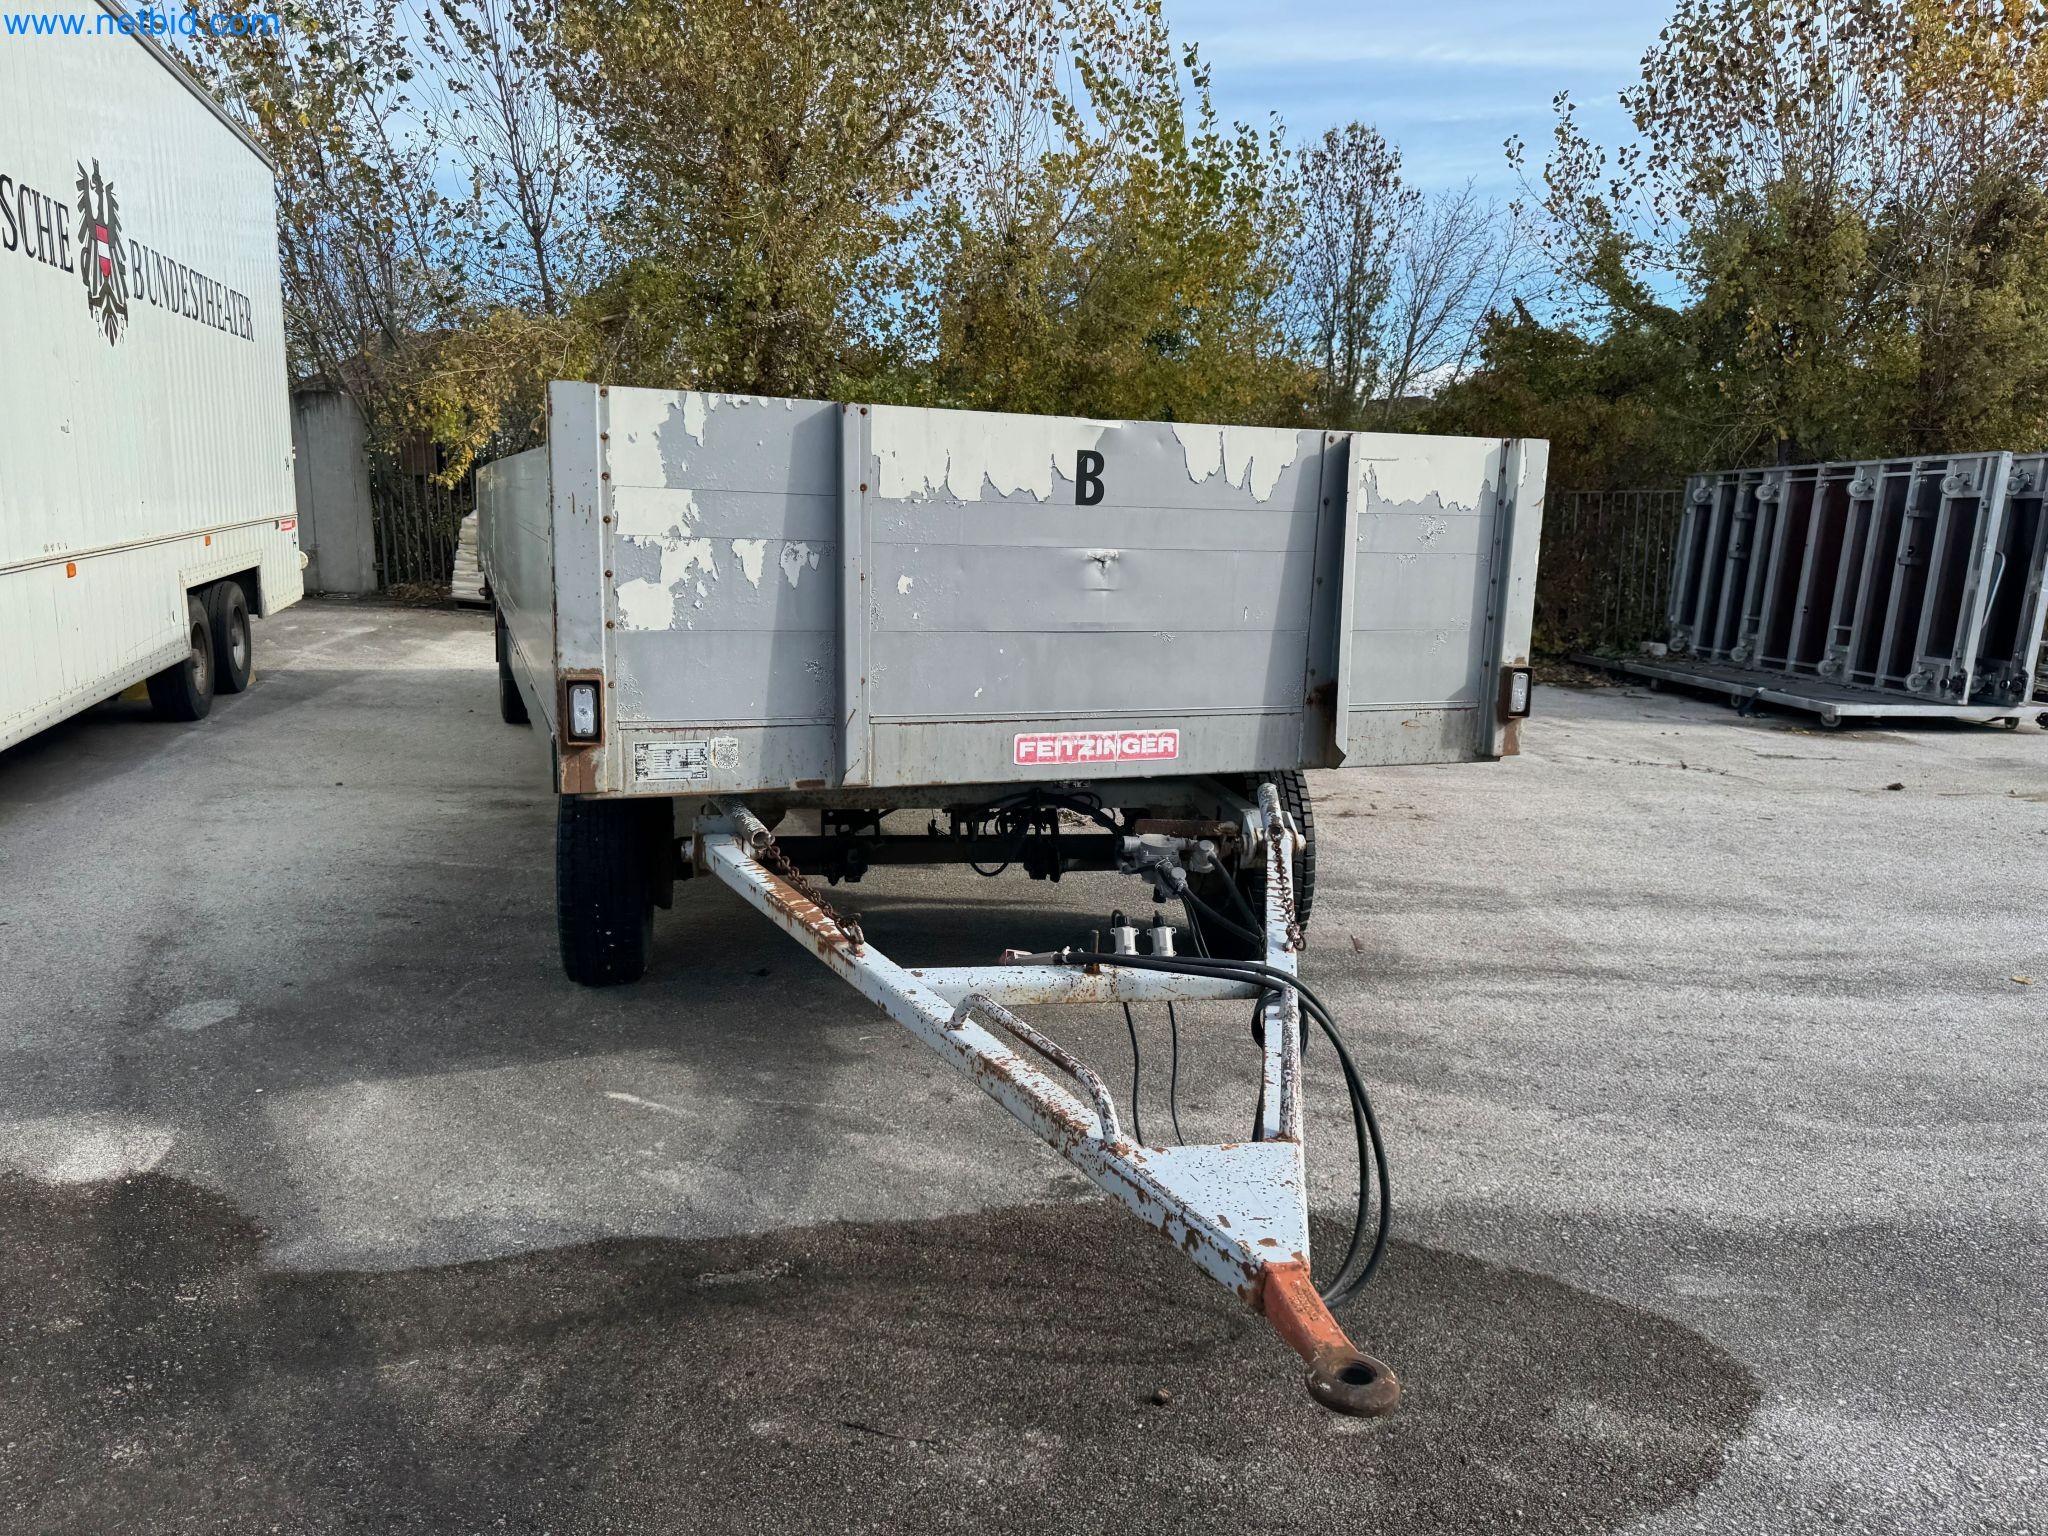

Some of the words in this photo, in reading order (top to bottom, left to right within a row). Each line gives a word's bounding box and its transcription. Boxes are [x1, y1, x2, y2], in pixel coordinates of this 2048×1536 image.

[128, 238, 255, 343] BUNDESTHEATER
[1075, 449, 1105, 506] B
[1018, 735, 1176, 758] FEITZINGER
